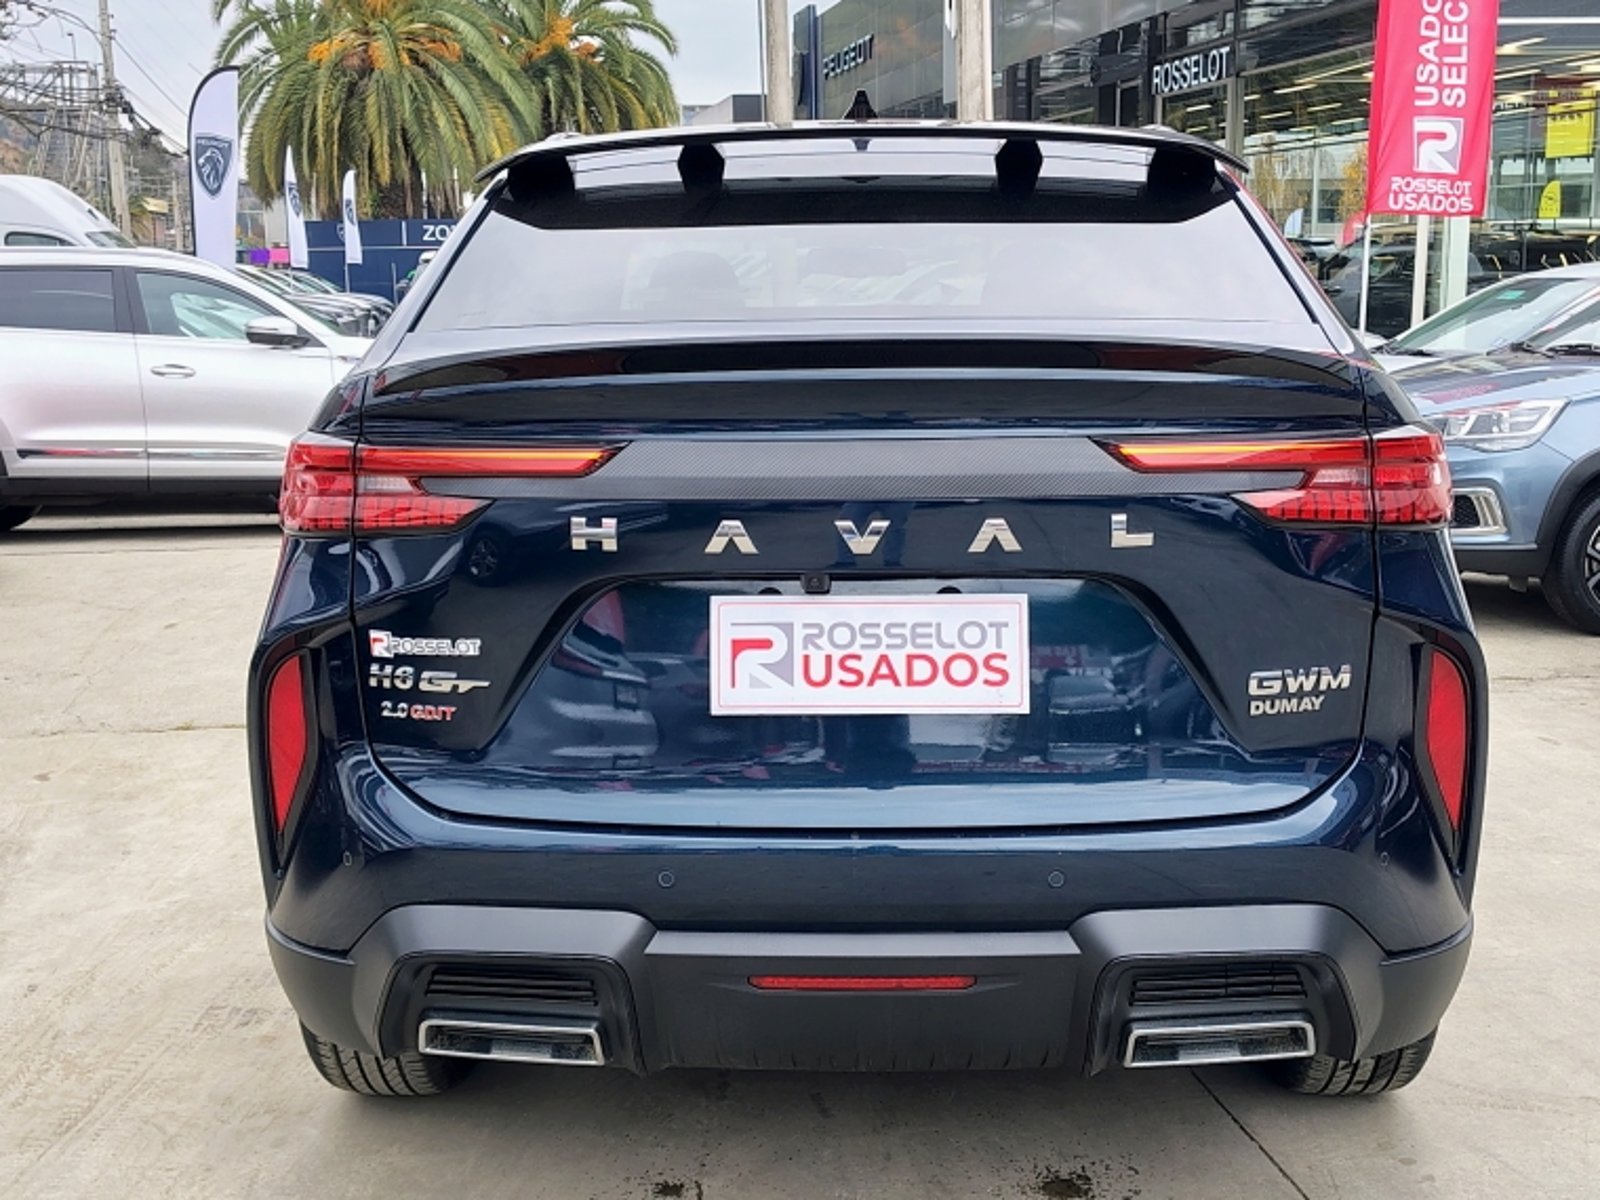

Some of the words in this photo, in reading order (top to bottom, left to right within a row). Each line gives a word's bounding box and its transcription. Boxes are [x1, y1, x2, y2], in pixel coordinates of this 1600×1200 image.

[822, 32, 875, 80] PEUGEOT
[1442, 1, 1469, 108] SELEC
[1151, 46, 1230, 95] ROSSELOT
[1391, 176, 1472, 195] ROSSELOT
[1389, 193, 1474, 213] USADOS
[570, 513, 1154, 555] HAVAL
[389, 637, 482, 656] ROSSELOT
[801, 621, 1009, 651] ROSSELOT
[368, 662, 415, 690] H6
[802, 653, 1010, 688] USADOS
[1248, 664, 1352, 695] GWM
[380, 700, 409, 719] 2.0
[1250, 695, 1325, 716] DUMAY
